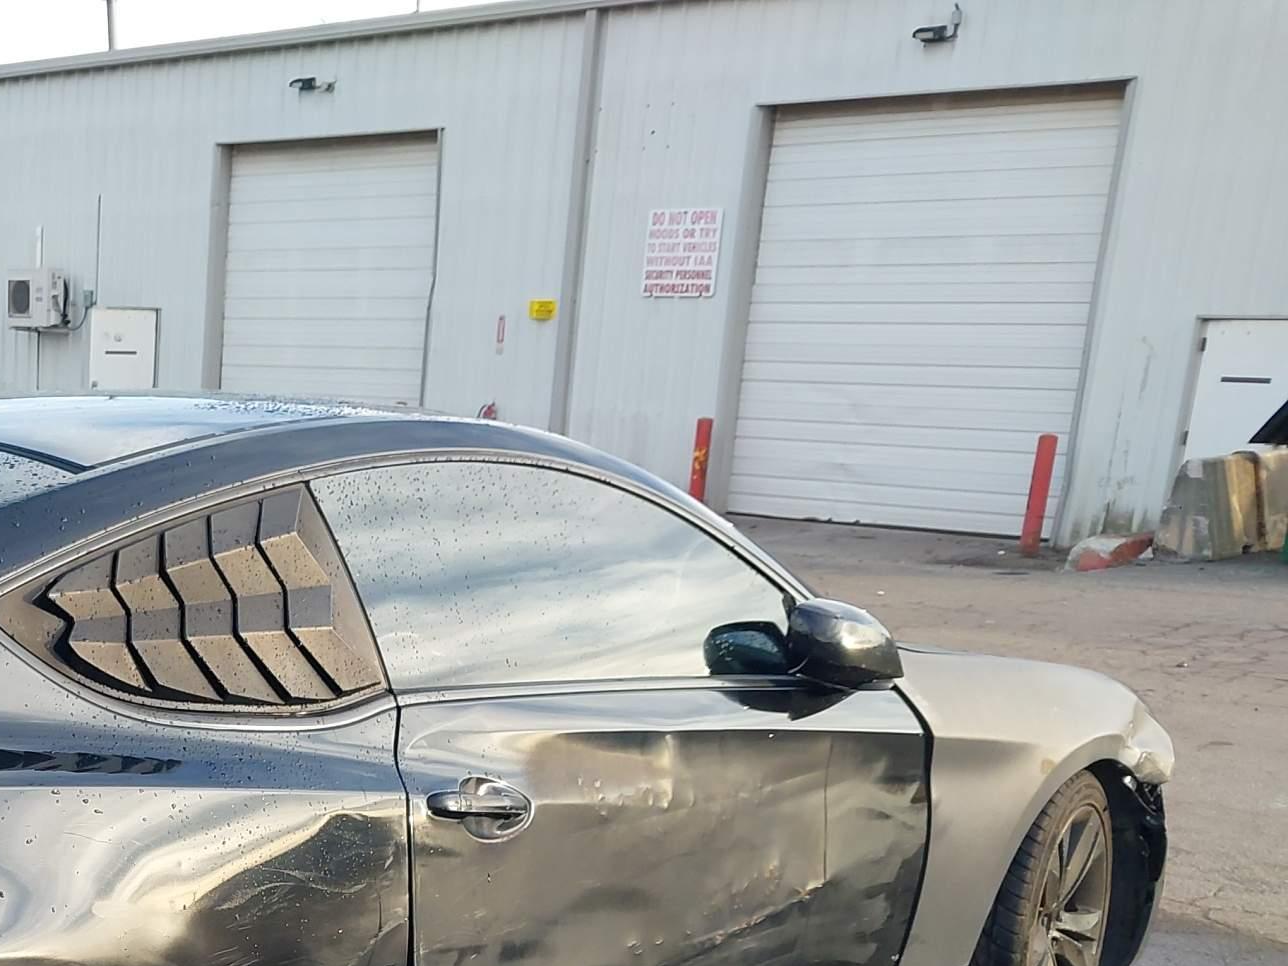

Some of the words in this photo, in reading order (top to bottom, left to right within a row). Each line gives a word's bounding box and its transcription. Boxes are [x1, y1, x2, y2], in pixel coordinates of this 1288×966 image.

[652, 211, 666, 226] DO
[669, 211, 688, 225] NOT
[691, 210, 717, 225] OPEN
[649, 228, 680, 239] HOODS
[682, 228, 696, 239] OR
[699, 228, 717, 238] TRY
[647, 242, 657, 253] TO
[657, 242, 681, 253] START
[683, 242, 717, 252] VEHICLES
[647, 256, 691, 266] WITHOUT
[694, 255, 713, 266] IAA
[643, 283, 710, 293] AUTHORIZATION
